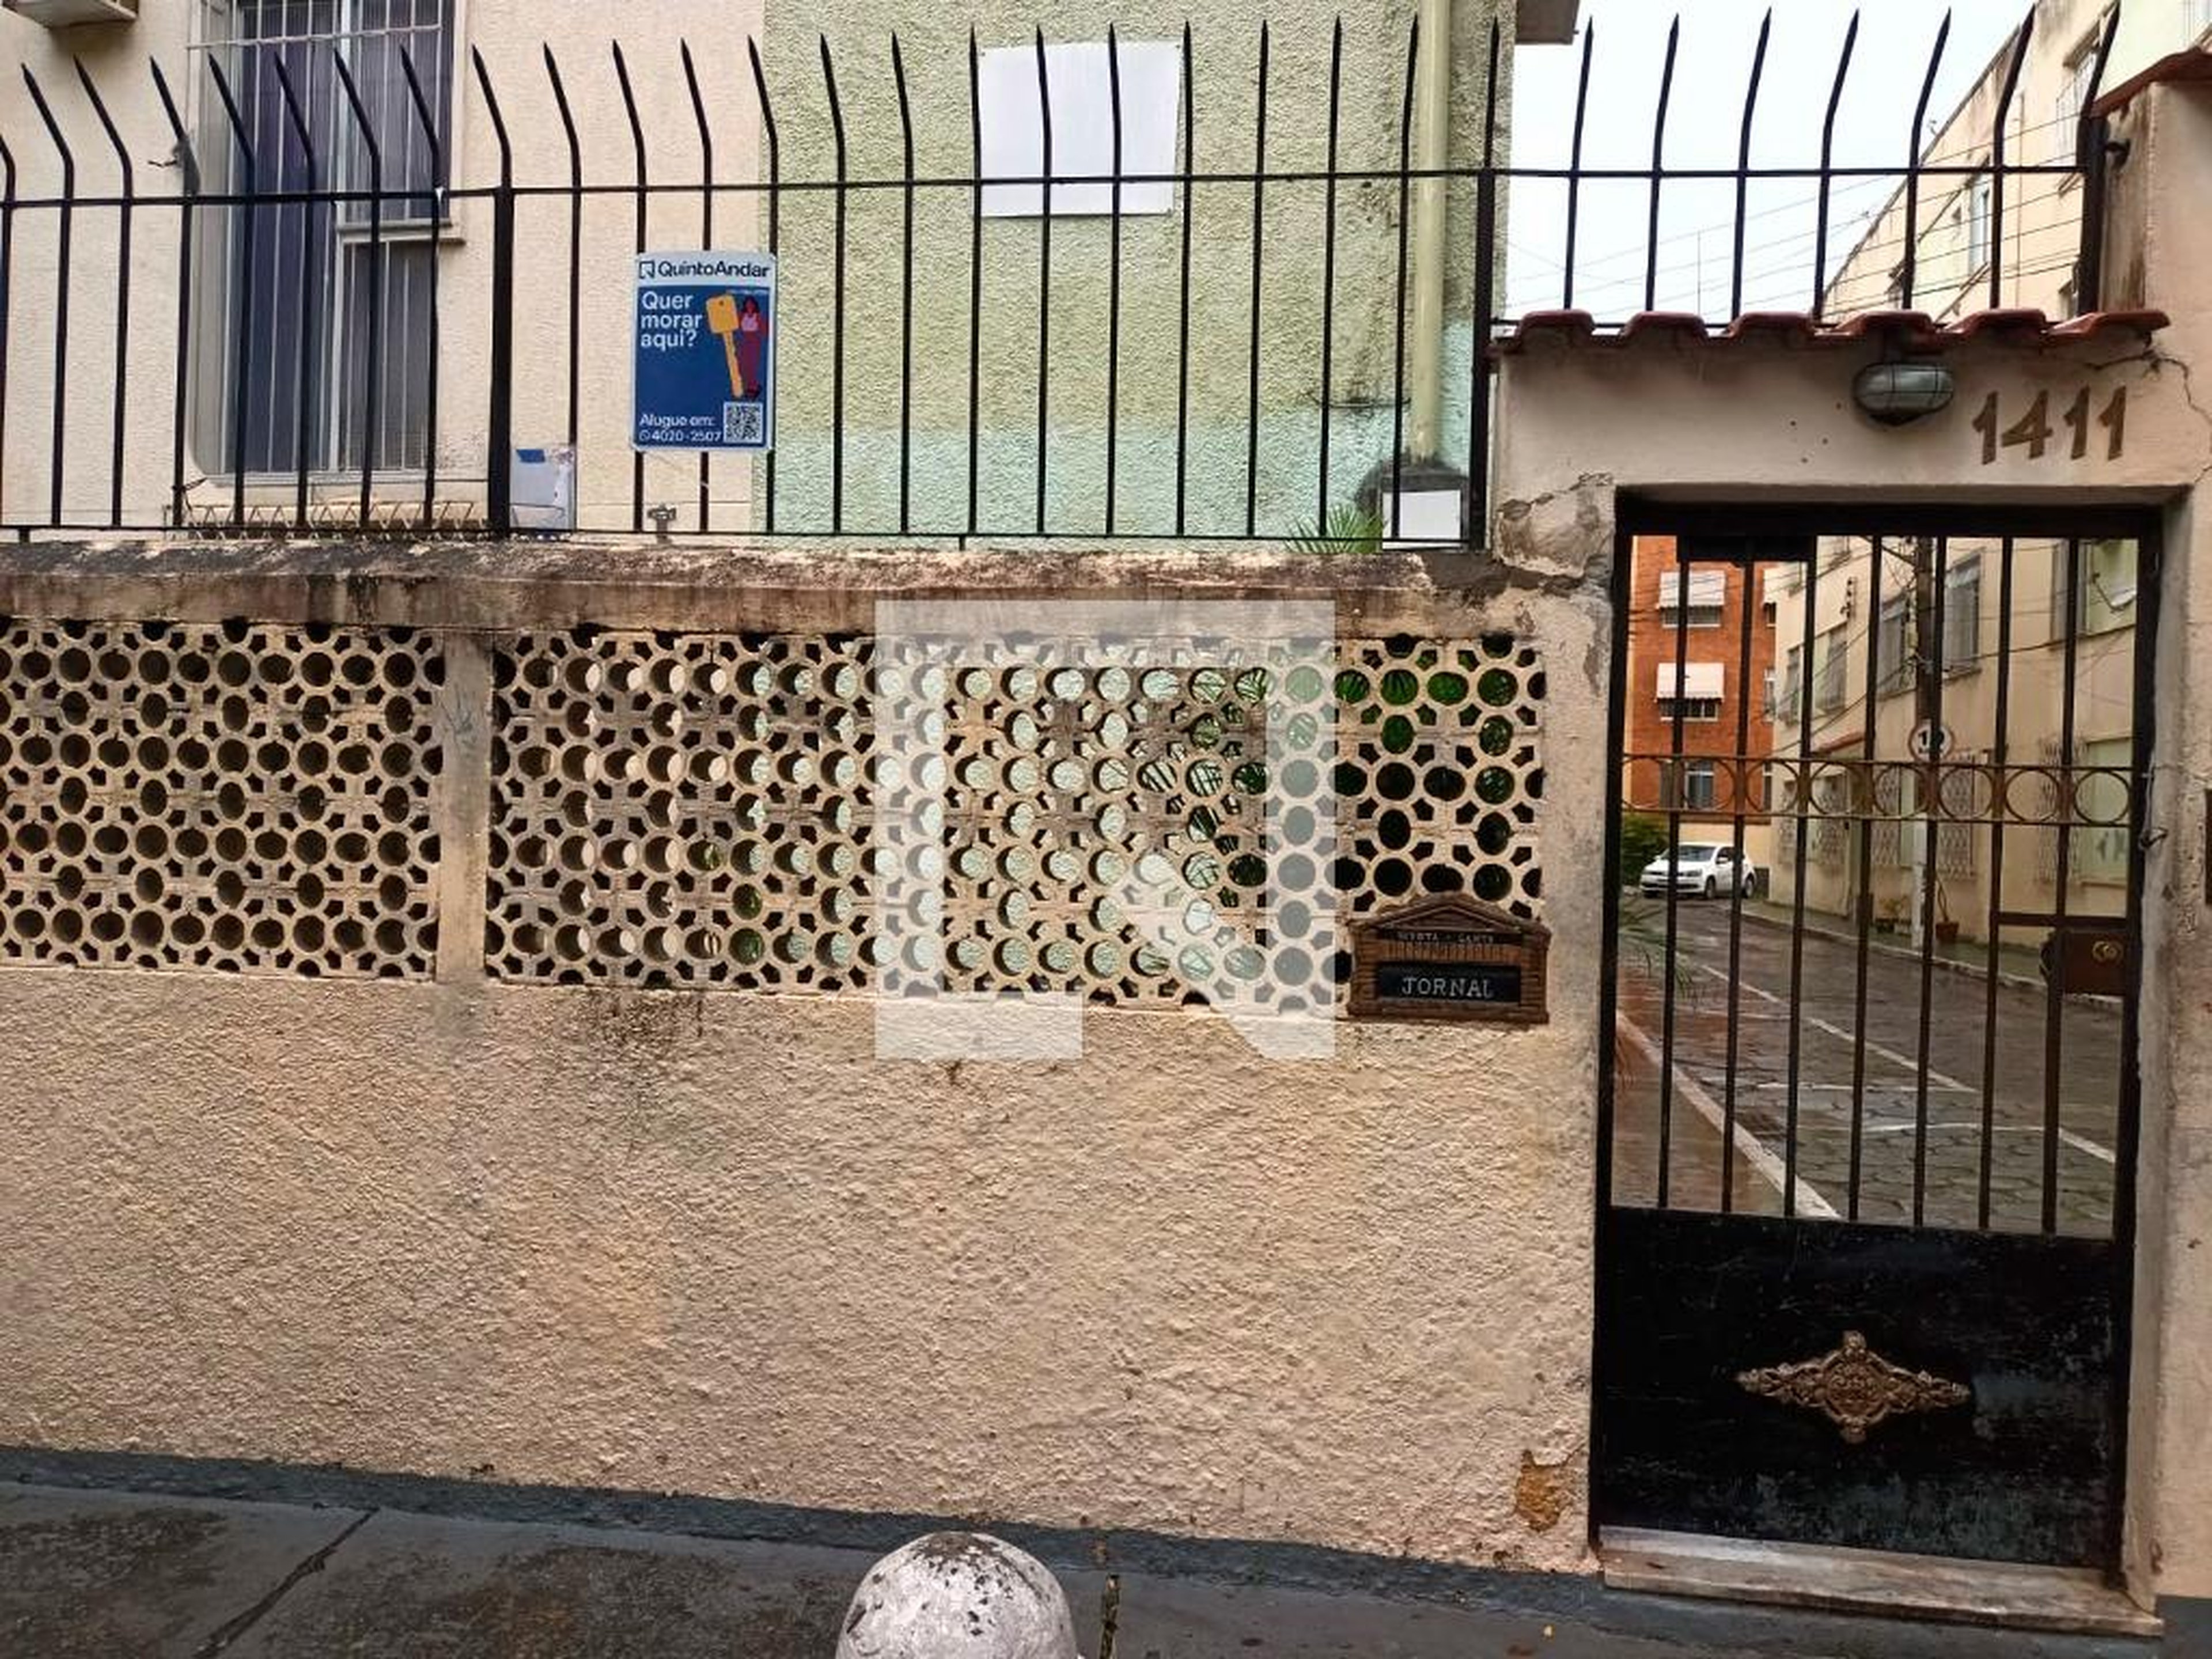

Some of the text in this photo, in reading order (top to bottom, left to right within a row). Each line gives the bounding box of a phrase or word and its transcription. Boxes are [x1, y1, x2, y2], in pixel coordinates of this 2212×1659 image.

[658, 260, 771, 278] QuintoAndar
[641, 290, 694, 310] Quer
[641, 314, 703, 329] morar
[641, 329, 698, 352] aqui?
[639, 414, 687, 429] Alugue
[1972, 384, 2127, 465] 1411
[1401, 976, 1494, 998] JORNAL
